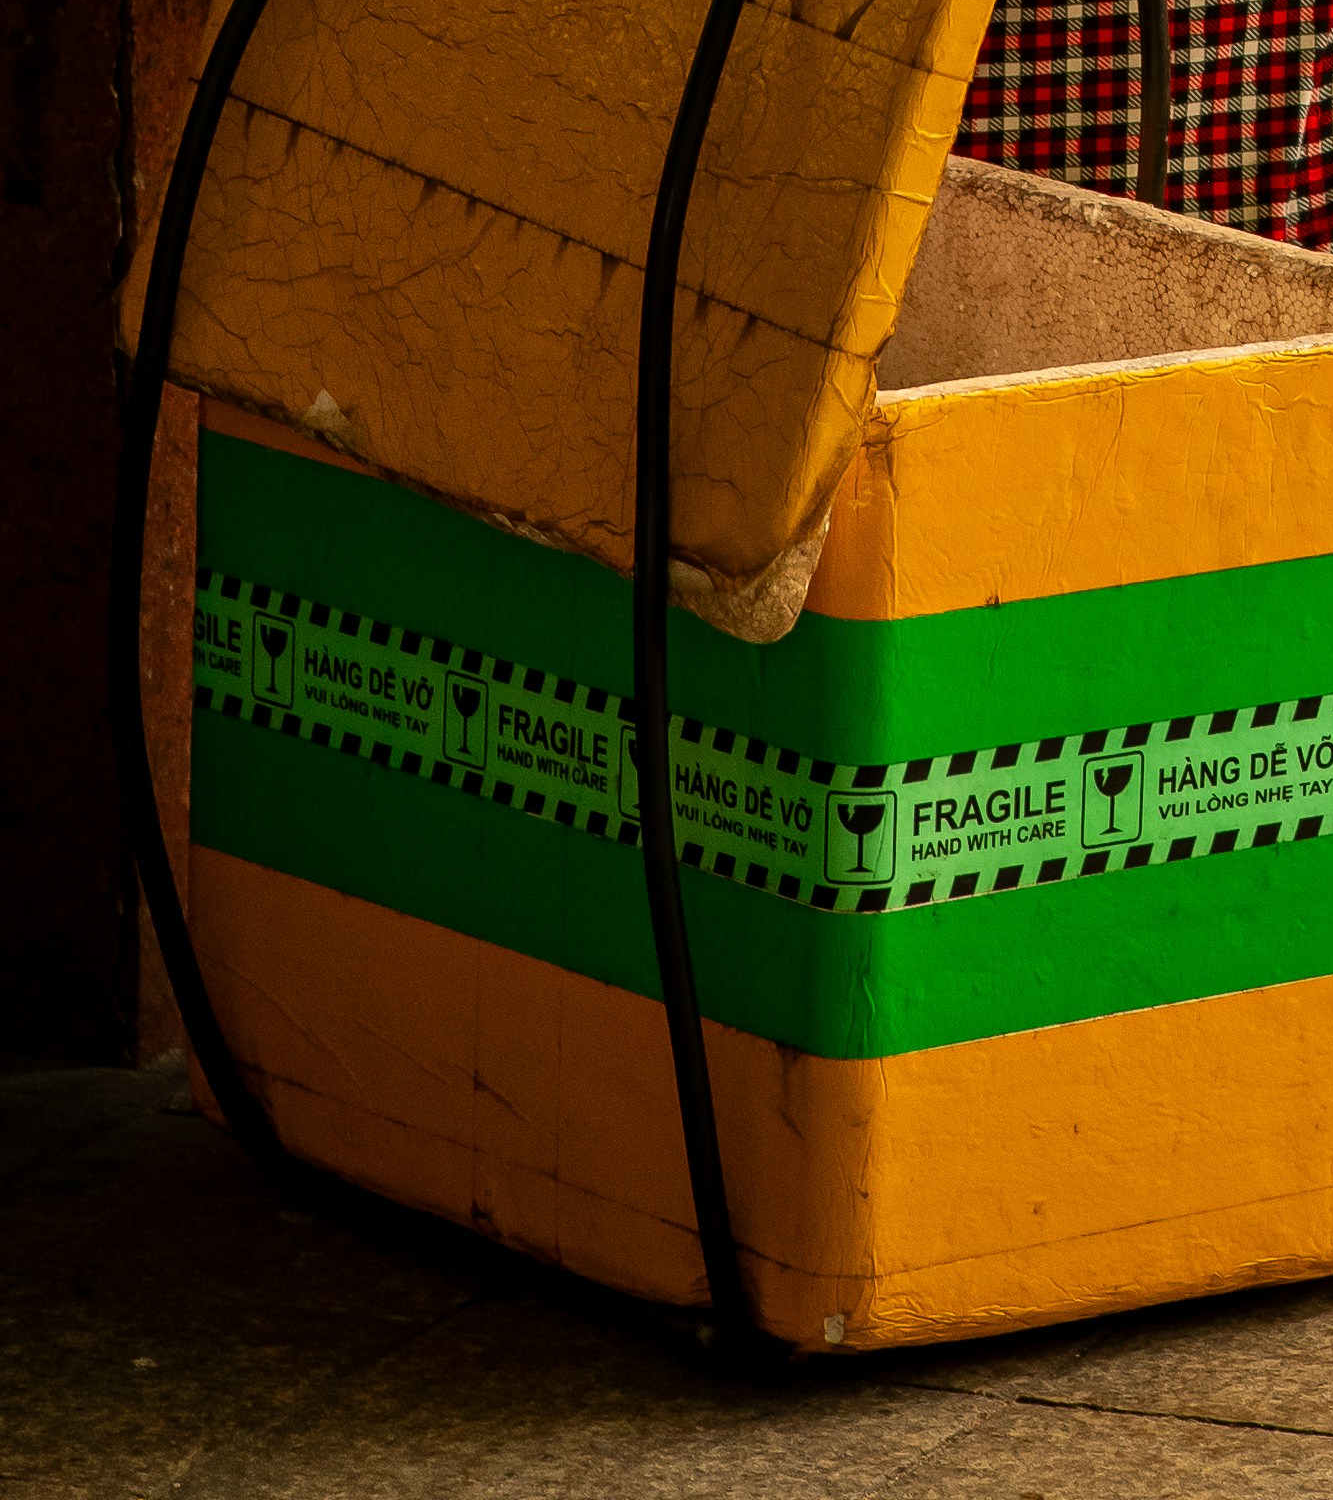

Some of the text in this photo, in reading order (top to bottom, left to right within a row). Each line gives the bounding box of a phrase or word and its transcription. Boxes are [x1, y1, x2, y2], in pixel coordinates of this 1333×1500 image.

[194, 608, 242, 653] GILE
[208, 652, 242, 677] CARE
[304, 644, 362, 690] HÀNG
[402, 676, 434, 711] VỠ
[304, 684, 327, 704] VUI
[331, 692, 369, 717] LÒNG
[405, 716, 430, 735] TAY
[498, 703, 608, 769] FRAGILE
[497, 743, 608, 793] HAND WITH CARE
[1158, 756, 1240, 795] HÀNG
[1250, 742, 1288, 780] DỄ
[675, 761, 738, 808] HÀNG
[779, 797, 813, 832] VỠ
[913, 779, 1066, 836] FRAGILE
[1158, 778, 1333, 820] VUI LÒNG NHẸ TAY
[675, 801, 808, 857] VUI LÒNG NHẸ TAY
[911, 819, 1066, 862] HAND WITH CARE
